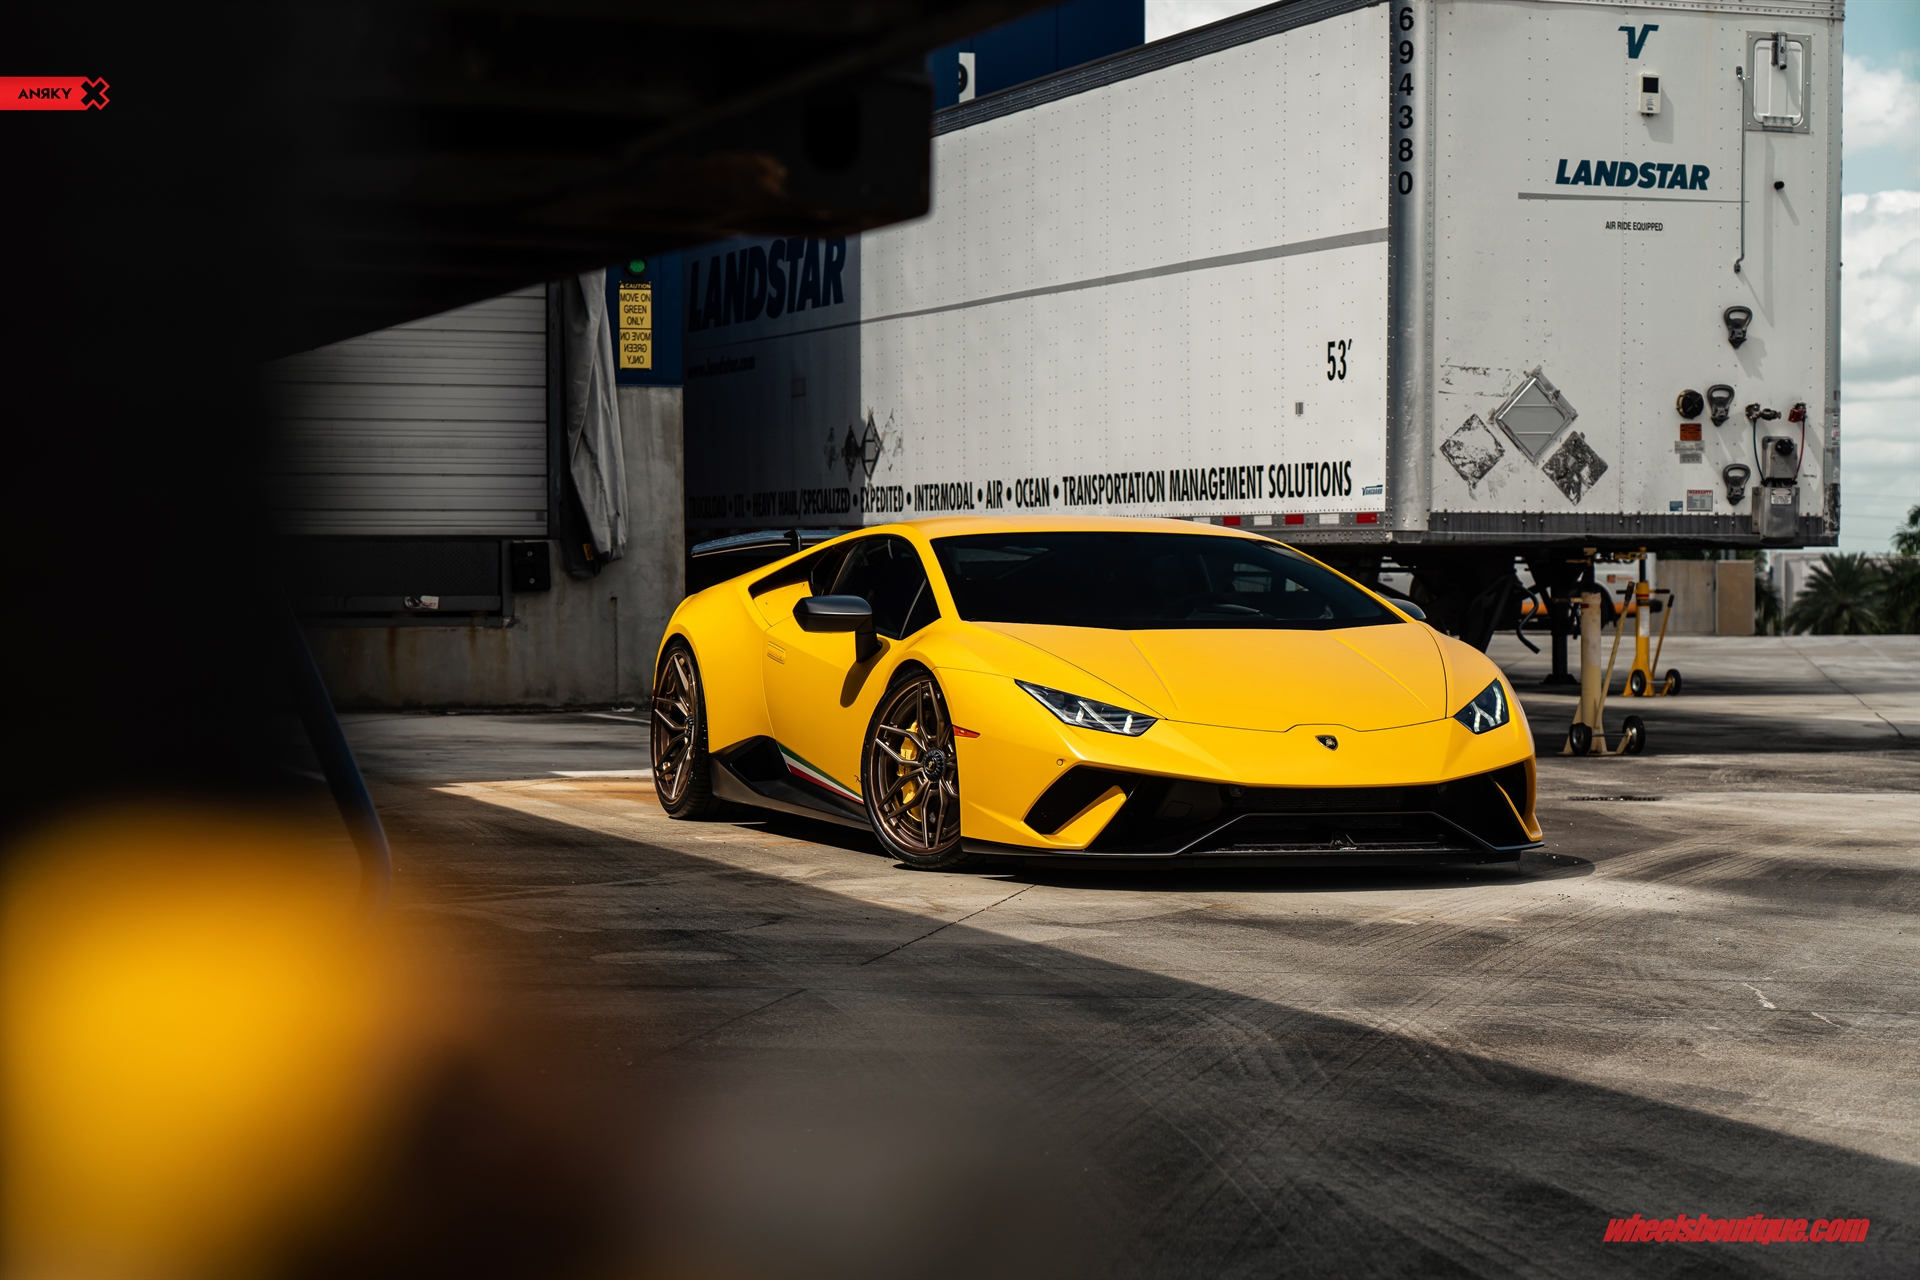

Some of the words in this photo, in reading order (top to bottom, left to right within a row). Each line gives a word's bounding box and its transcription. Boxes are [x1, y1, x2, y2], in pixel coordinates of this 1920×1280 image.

[1398, 6, 1415, 196] 694380
[1555, 158, 1711, 191] LANDSTAR
[1605, 221, 1616, 230] AIR
[1617, 221, 1632, 231] RIDE
[1633, 221, 1664, 232] EQUIPPED
[620, 293, 639, 302] MOVE
[640, 293, 651, 302] ON
[688, 237, 847, 333] LANDSTAR
[623, 304, 647, 314] GREEN
[626, 316, 645, 326] ONLY
[687, 355, 755, 379] www.landstar.com
[1326, 338, 1353, 381] 53'
[688, 495, 727, 519] TRUCKLOAD
[753, 491, 777, 517] HEAVY
[860, 485, 904, 513] EXPEDITED
[914, 481, 975, 511] INTERMODAL
[986, 480, 1003, 509] AIR
[1015, 477, 1050, 508] OCEAN
[1062, 470, 1165, 507] TRANSPORTATION
[1169, 465, 1264, 502] MANAGEMENT
[1268, 460, 1352, 499] SOLUTIONS
